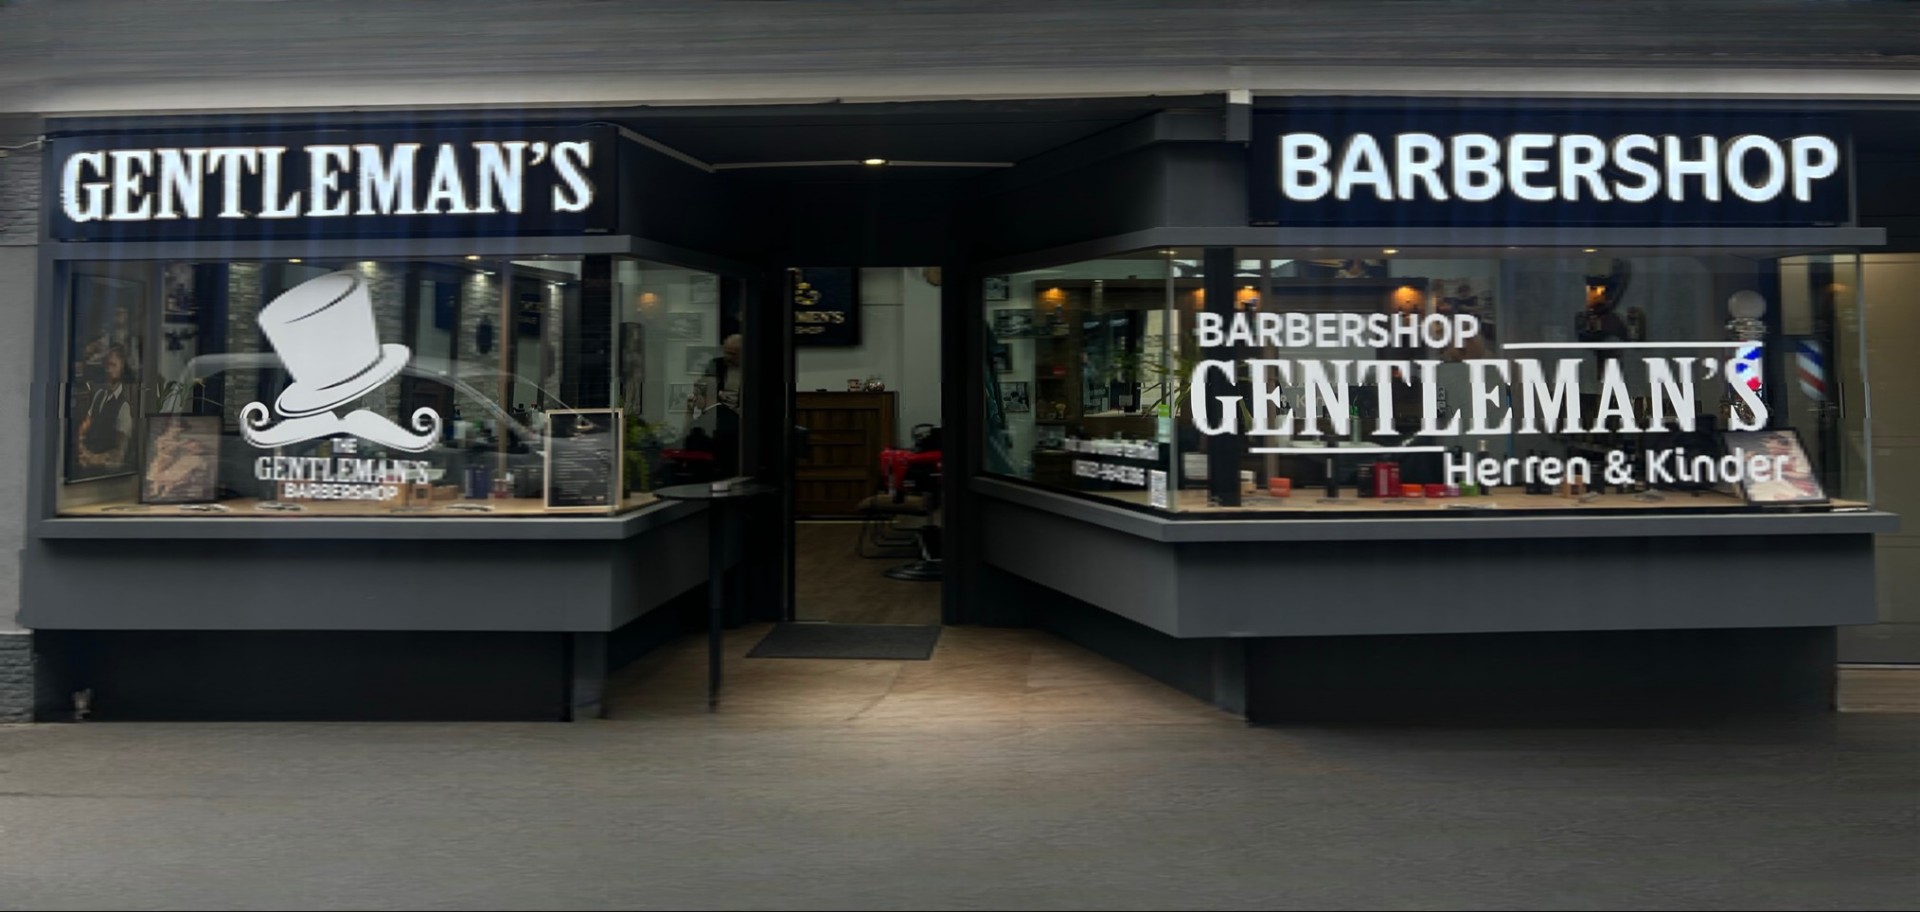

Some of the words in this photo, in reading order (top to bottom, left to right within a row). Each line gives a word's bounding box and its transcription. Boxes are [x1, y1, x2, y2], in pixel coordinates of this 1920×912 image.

[61, 142, 594, 222] GENTLEMAN'S
[1281, 133, 1838, 202] BARBERSHOP
[1197, 313, 1479, 349] BARBERSHOP
[1190, 357, 1769, 436] GENTLEMAN'S
[331, 437, 358, 454] THE
[1444, 450, 1591, 488] Herren
[1605, 449, 1636, 484] &
[1646, 447, 1790, 484] Kinder
[284, 483, 399, 501] BARBERSHOP
